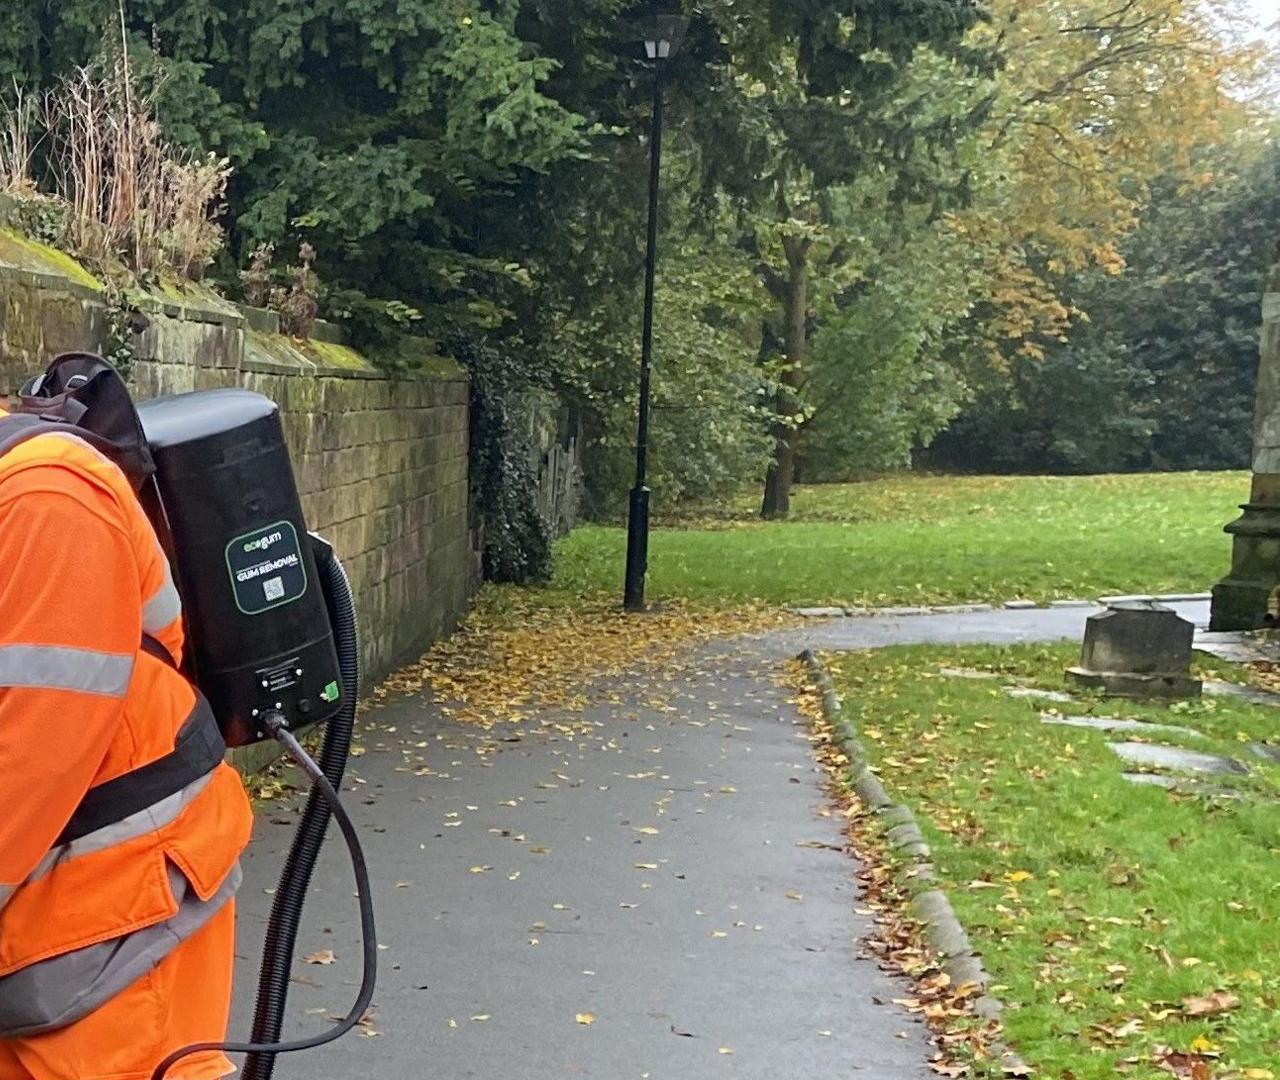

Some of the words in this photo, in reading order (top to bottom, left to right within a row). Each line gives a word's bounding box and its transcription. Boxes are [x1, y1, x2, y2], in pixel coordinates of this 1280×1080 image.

[243, 531, 282, 552] ecogum
[236, 567, 260, 582] GUM
[258, 553, 299, 575] REMOVAL
